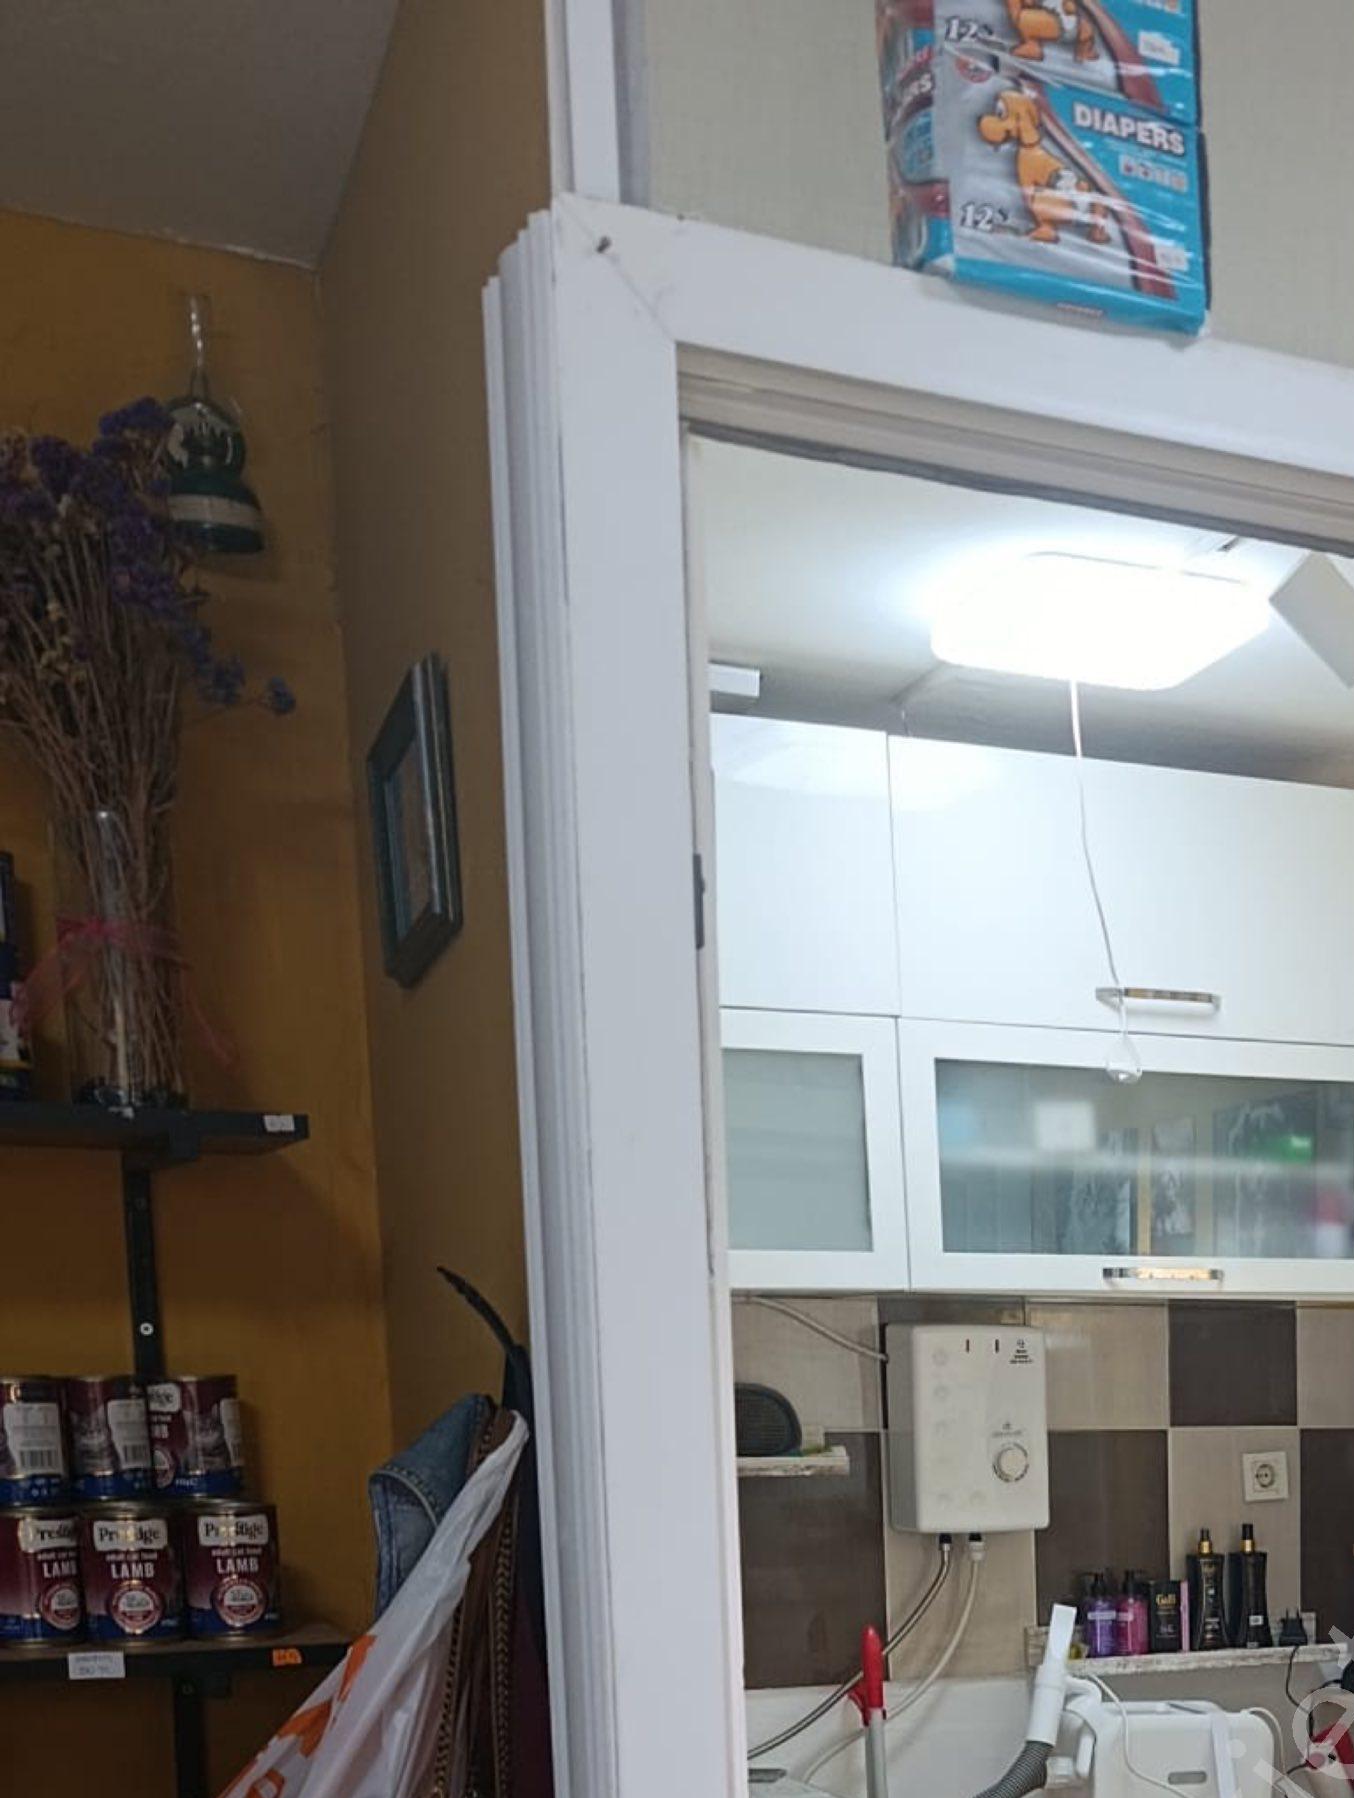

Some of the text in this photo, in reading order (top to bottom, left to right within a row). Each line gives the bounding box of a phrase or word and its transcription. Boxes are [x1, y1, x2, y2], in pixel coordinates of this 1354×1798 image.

[1073, 101, 1185, 156] DIAPERS
[110, 1562, 155, 1579] LAMB
[216, 1557, 259, 1575] LAMB
